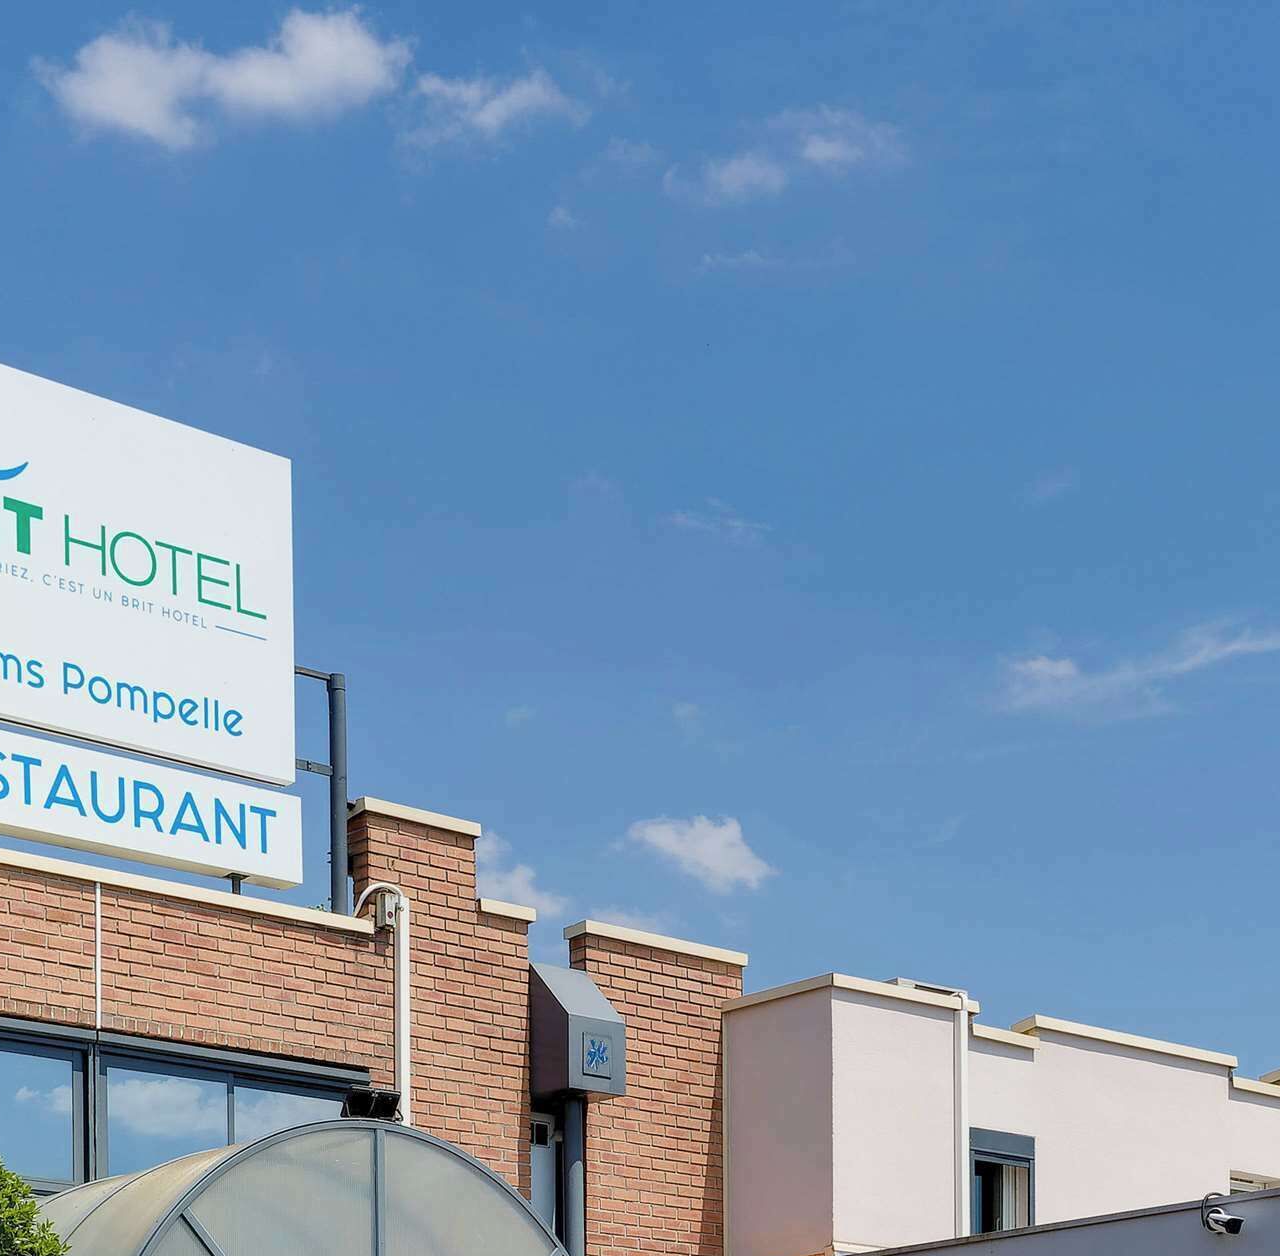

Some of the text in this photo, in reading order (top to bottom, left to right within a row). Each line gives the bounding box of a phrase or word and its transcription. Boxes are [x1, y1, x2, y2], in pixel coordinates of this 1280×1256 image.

[42, 573, 86, 595] C'EST
[92, 586, 113, 602] UN
[121, 594, 154, 614] BRIT
[161, 606, 208, 630] HOTEL
[63, 513, 267, 621] HOTEL
[62, 661, 245, 737] Pompelle
